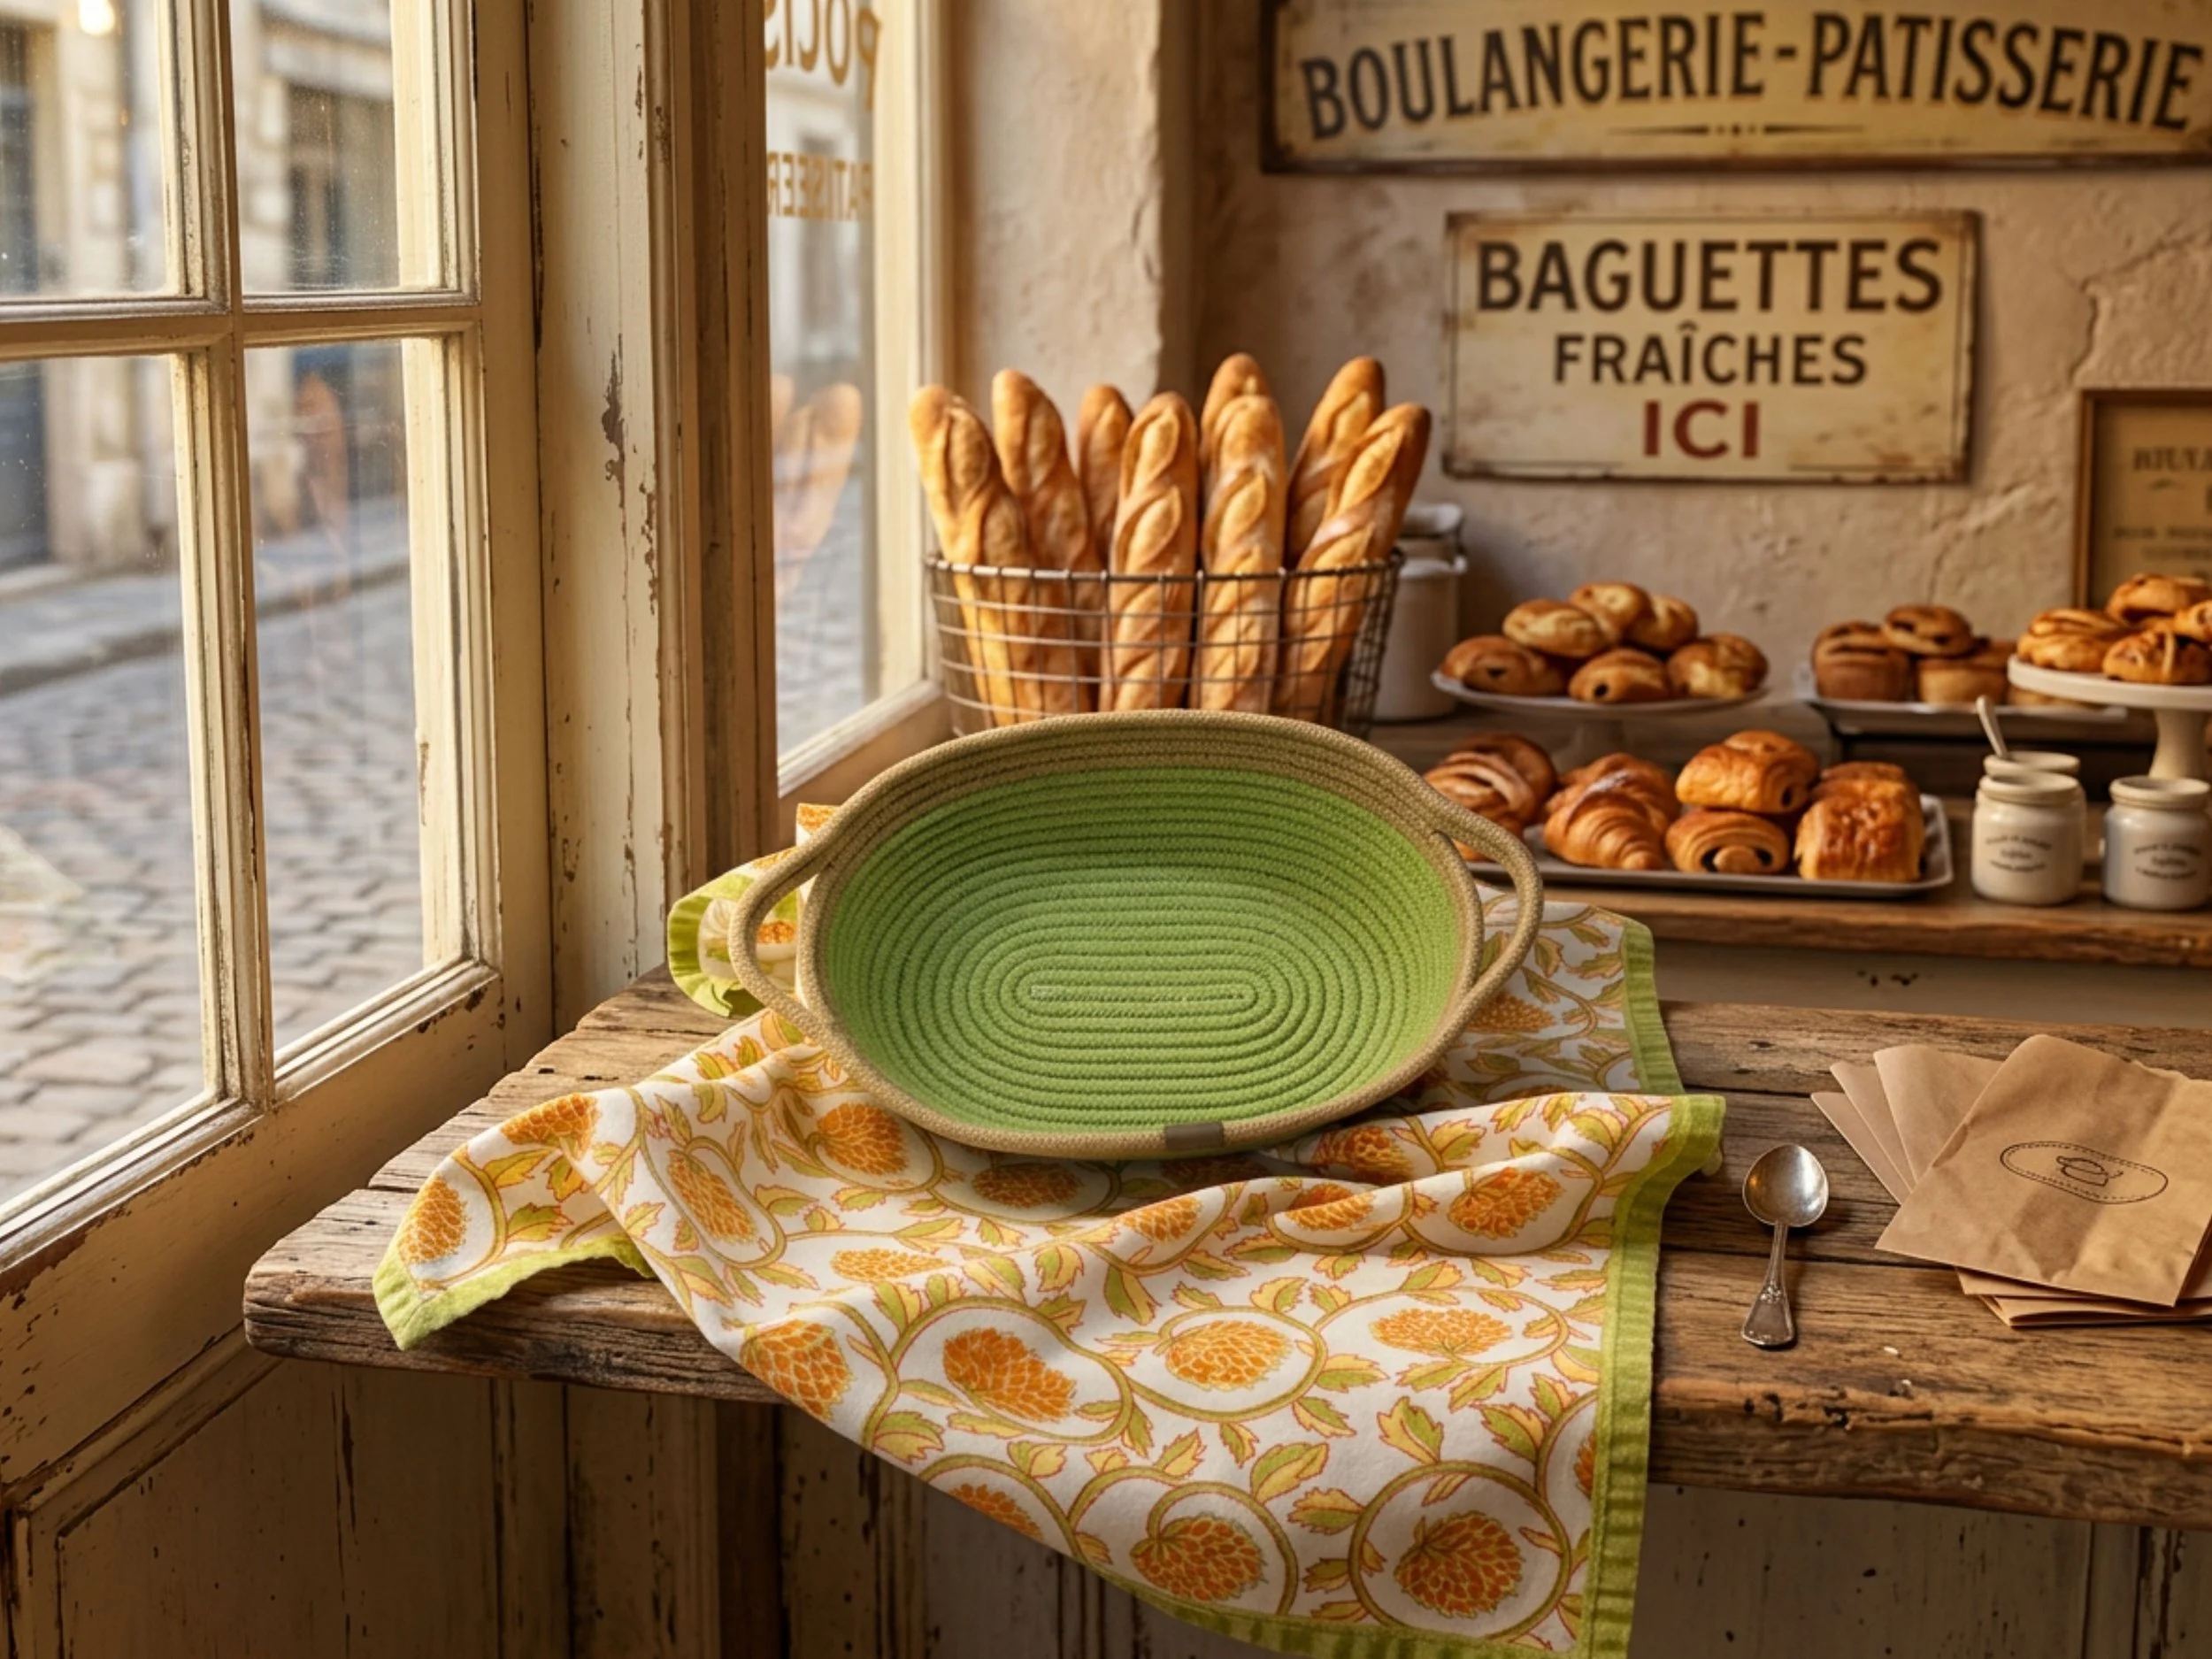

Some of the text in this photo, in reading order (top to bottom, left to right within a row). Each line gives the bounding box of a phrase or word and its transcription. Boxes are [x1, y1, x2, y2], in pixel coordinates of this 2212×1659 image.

[1300, 12, 2204, 141] BOULANGERIE-PATISSERIE
[1477, 238, 1942, 313] BAGUETTES
[1553, 320, 1868, 386] FRAÎCHES
[1643, 399, 1761, 459] ICI
